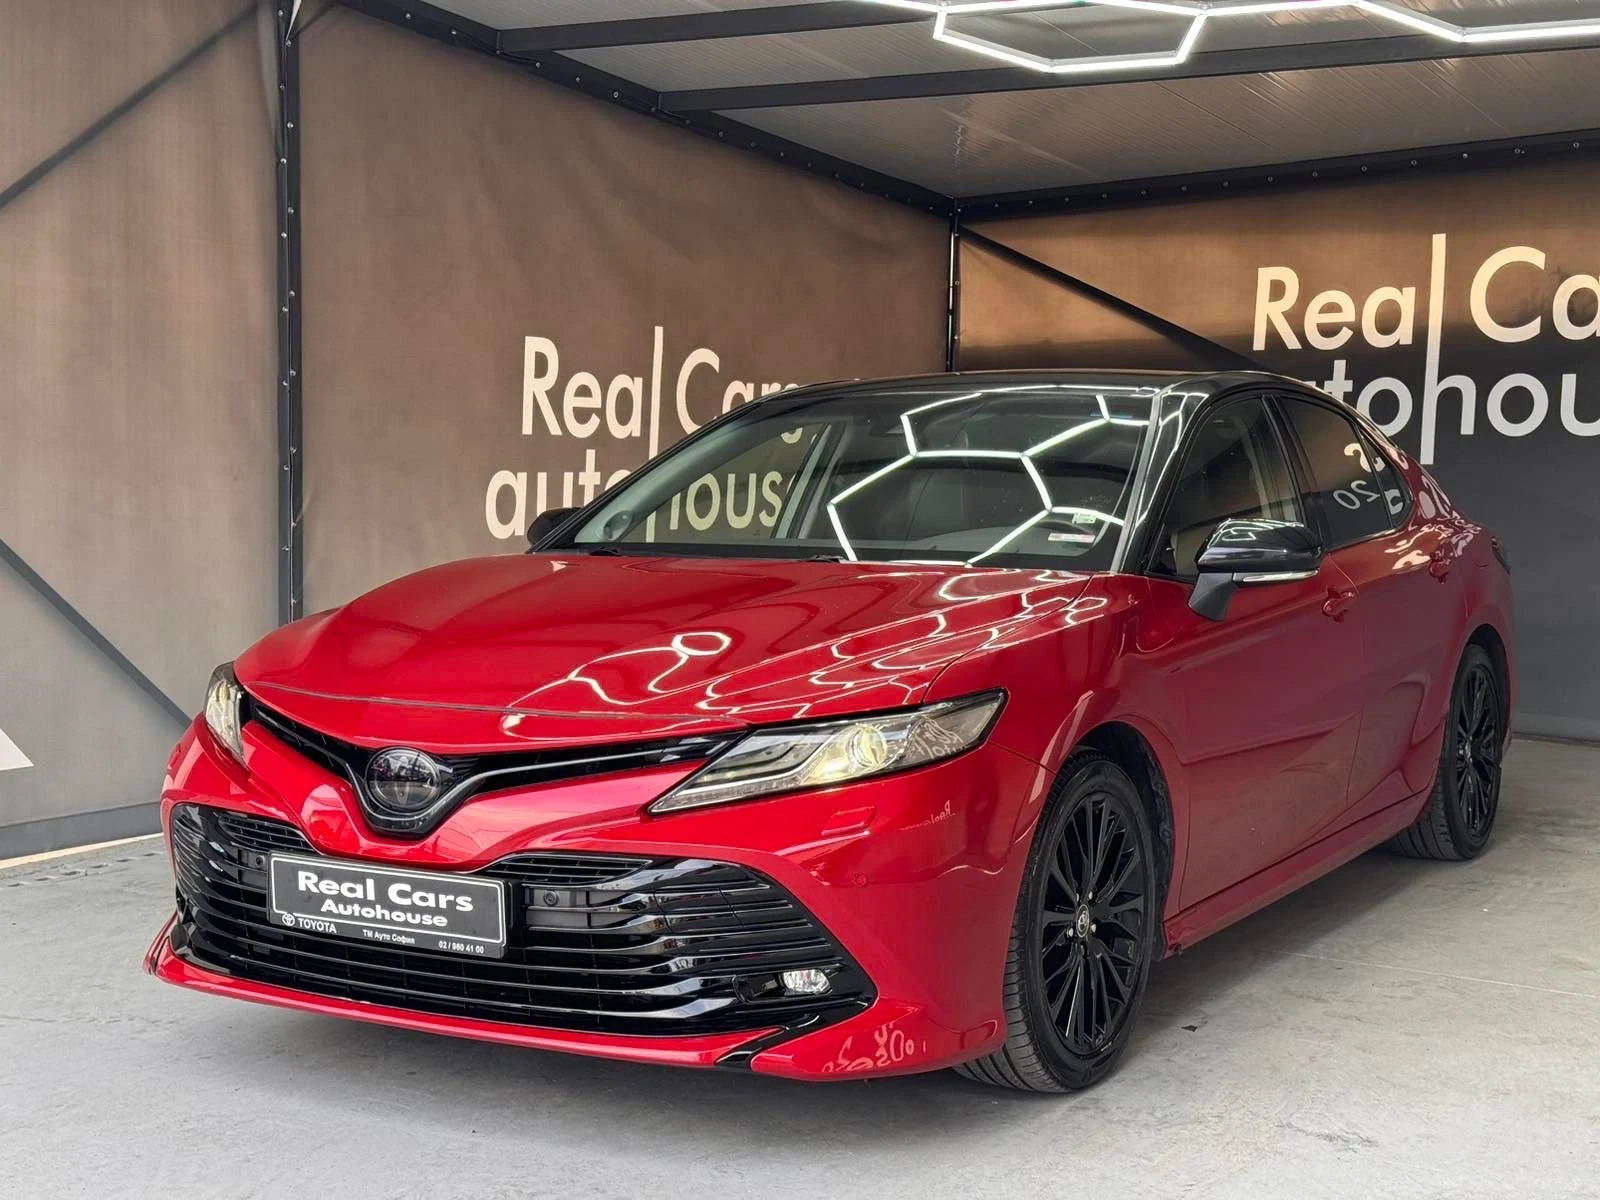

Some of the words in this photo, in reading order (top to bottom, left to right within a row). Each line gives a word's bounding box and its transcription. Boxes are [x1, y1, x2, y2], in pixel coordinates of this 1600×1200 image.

[1253, 233, 1447, 352] Real
[521, 326, 663, 460] Real
[298, 870, 376, 900] Real
[388, 883, 474, 912] Cars
[298, 917, 337, 934] TOYOTA
[321, 899, 448, 927] Autohouse
